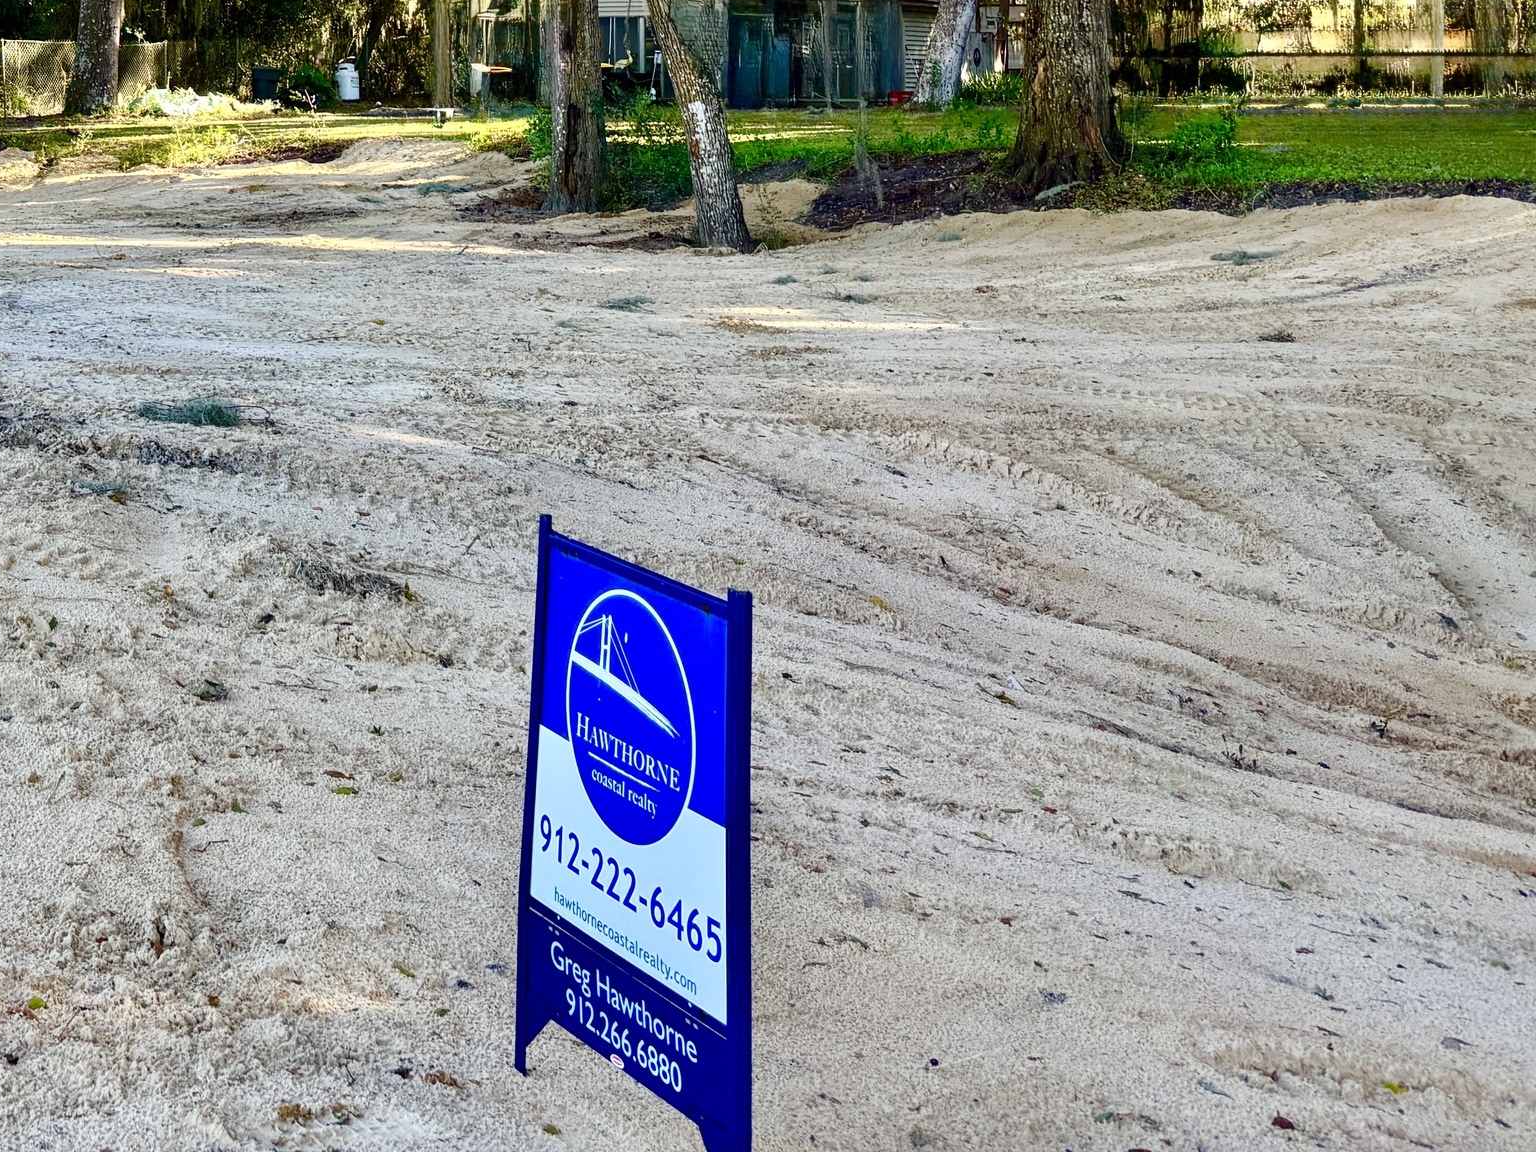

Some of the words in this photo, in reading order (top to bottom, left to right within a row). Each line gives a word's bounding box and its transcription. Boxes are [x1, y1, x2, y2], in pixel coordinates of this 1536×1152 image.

[576, 711, 681, 792] HAWTHORNE
[591, 769, 625, 798] coastal
[628, 789, 658, 819] realty
[540, 814, 722, 963] 912-222-6465
[554, 886, 697, 995] hawthornecoastalrealty.com
[550, 941, 592, 998] Greg
[595, 968, 698, 1063] Hawthorne
[565, 988, 682, 1092] 912.266.6880
